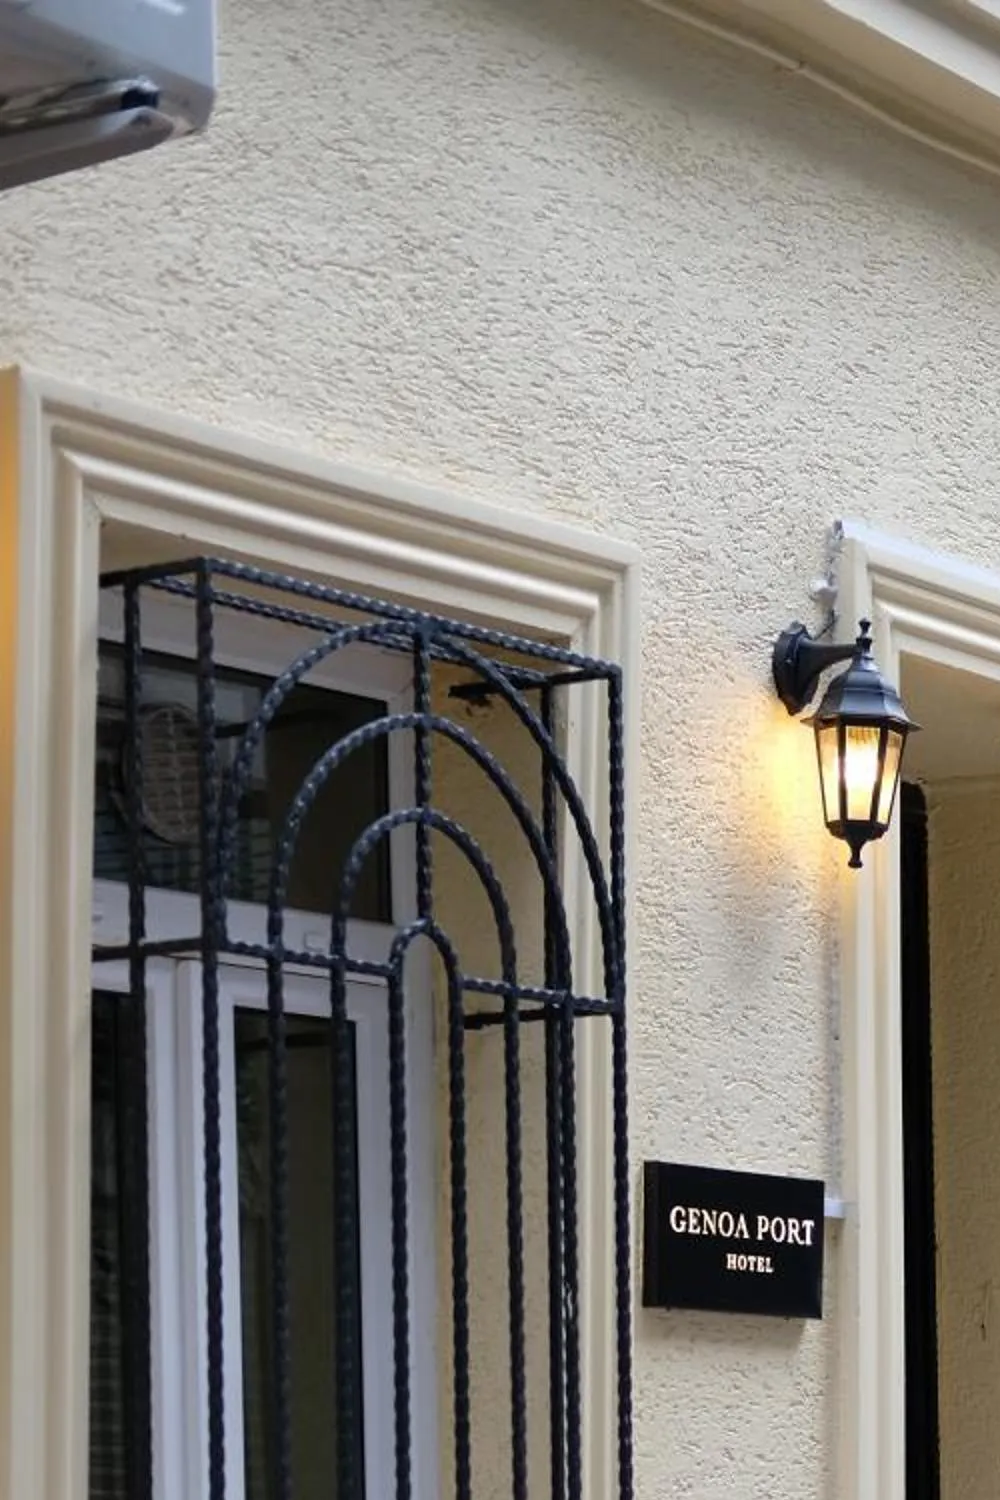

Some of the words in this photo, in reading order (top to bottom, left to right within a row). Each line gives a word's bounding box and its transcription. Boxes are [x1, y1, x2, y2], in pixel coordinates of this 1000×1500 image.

[669, 1205, 750, 1239] GENOA
[756, 1215, 815, 1246] PORT
[726, 1253, 774, 1274] HOTEL
